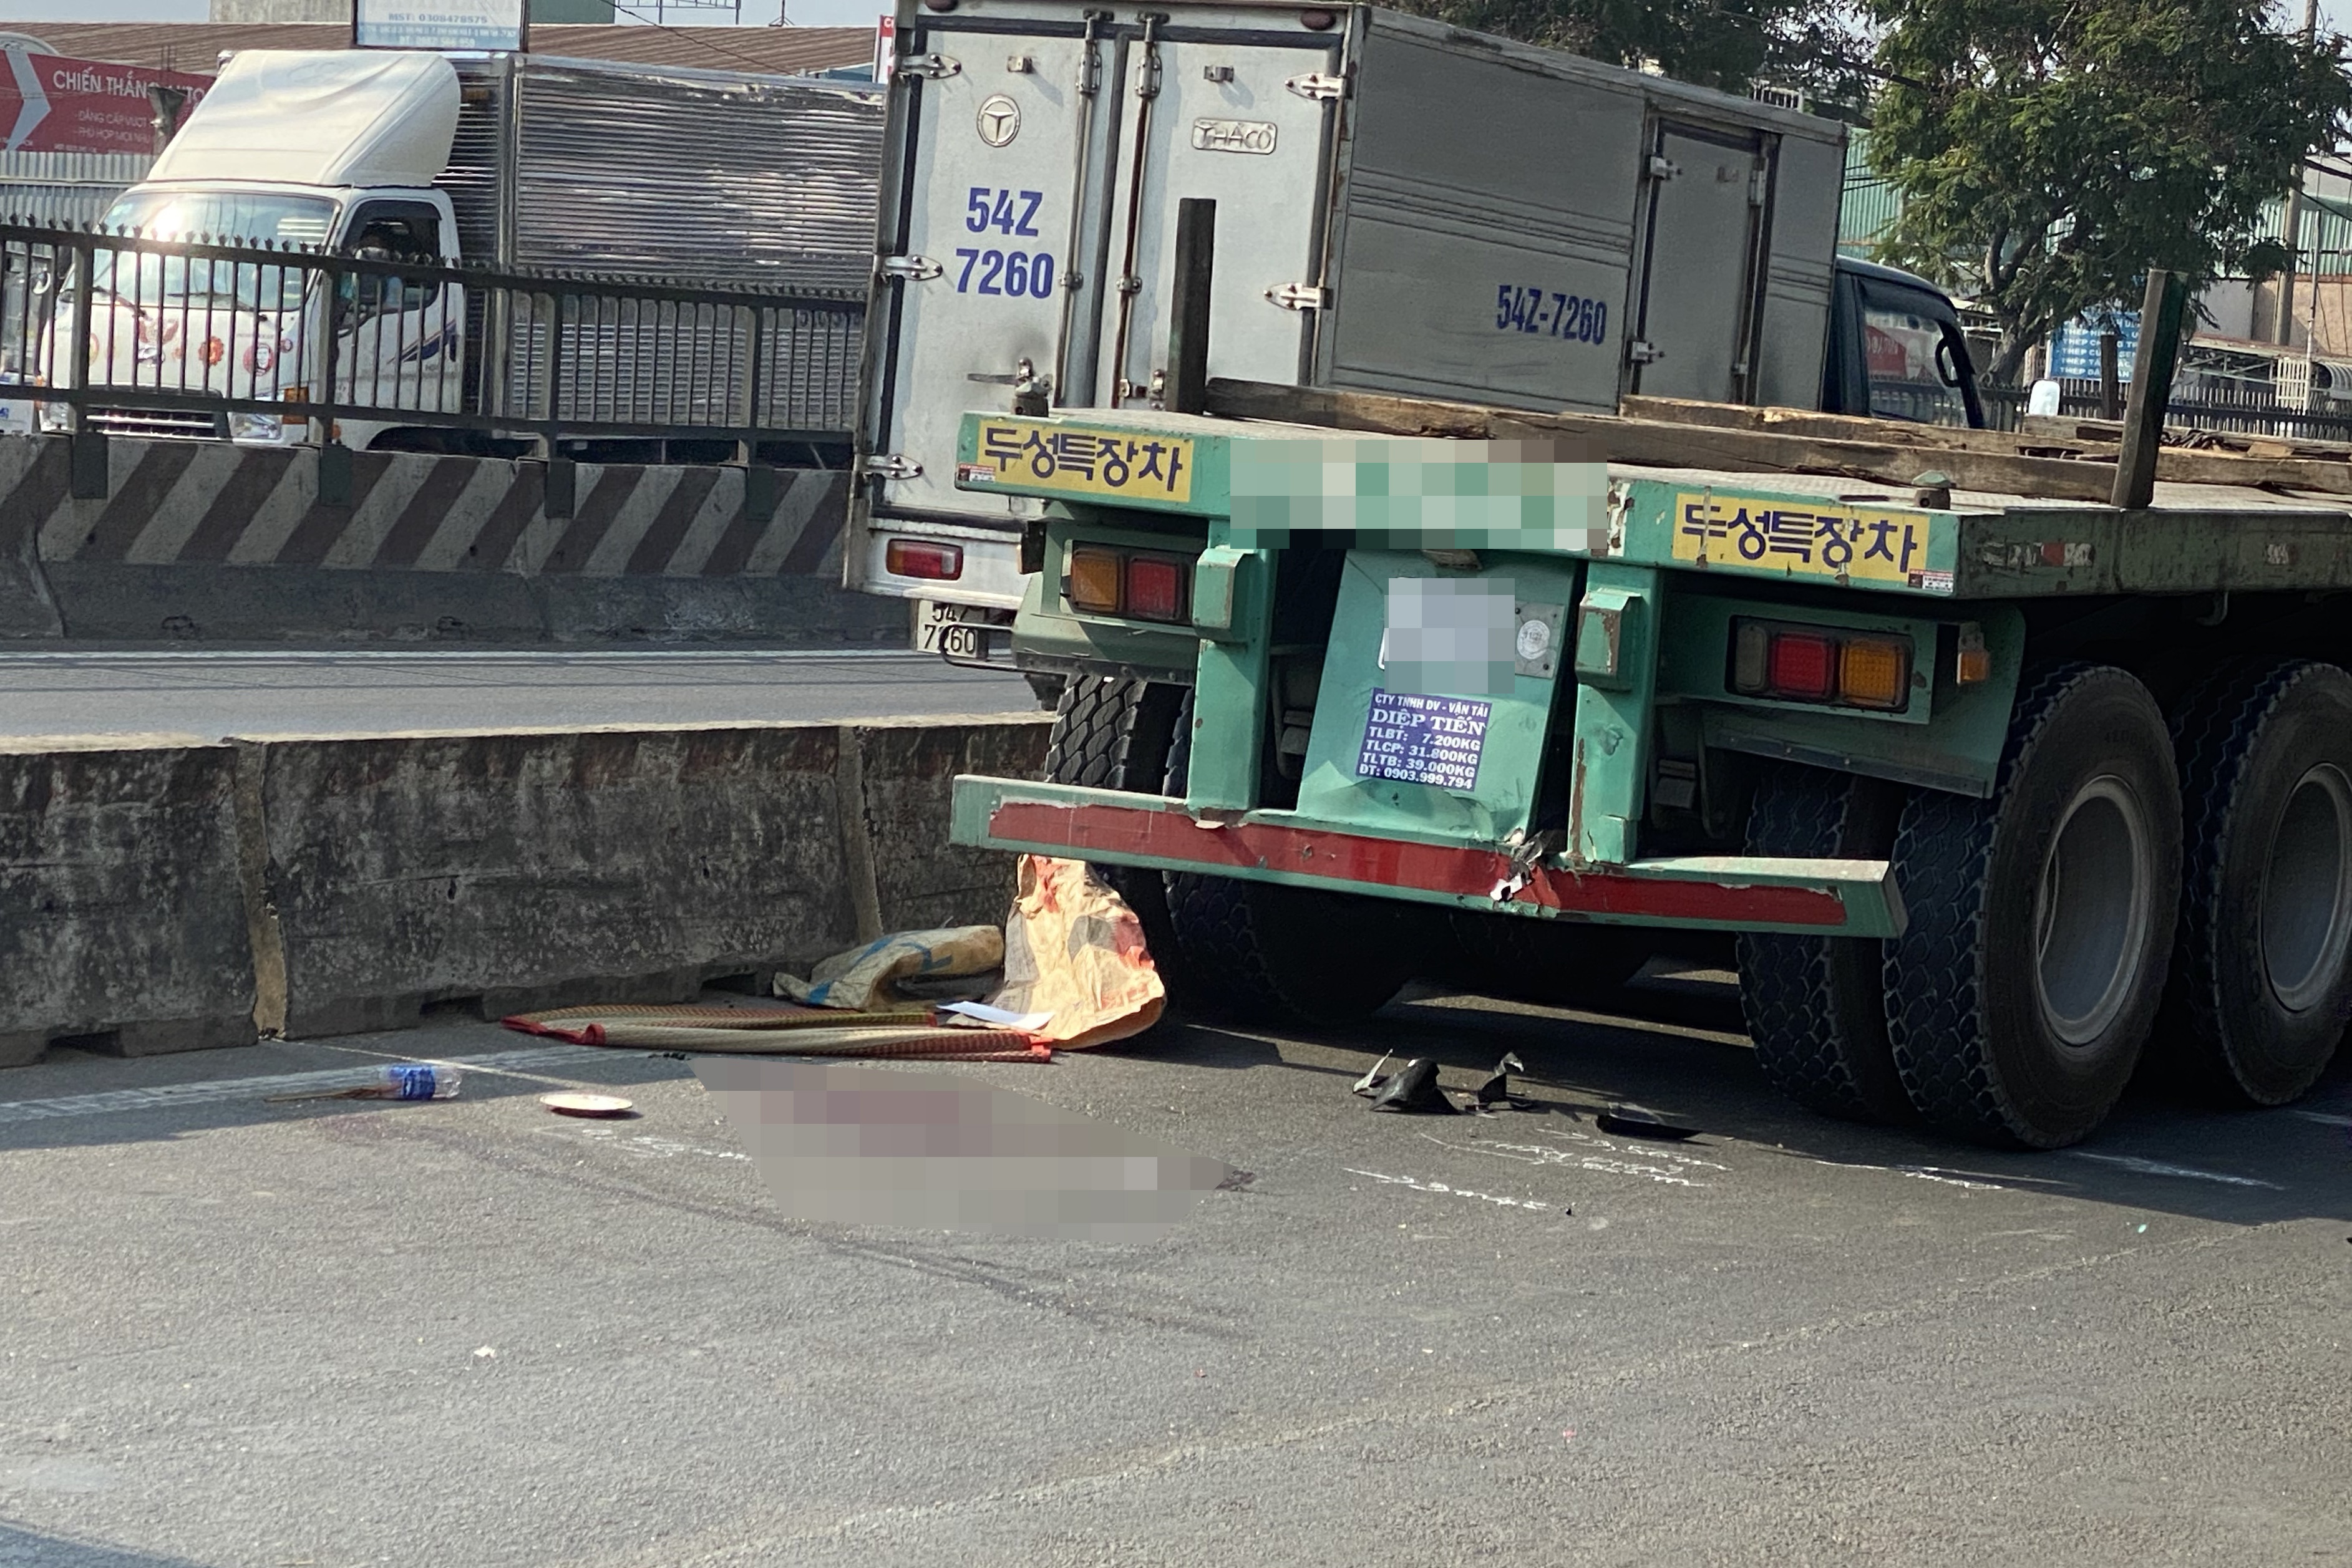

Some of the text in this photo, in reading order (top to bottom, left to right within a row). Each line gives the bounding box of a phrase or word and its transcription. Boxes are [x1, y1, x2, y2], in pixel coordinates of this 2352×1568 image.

[53, 66, 101, 92] CHIẾN
[106, 70, 158, 99] THẮN
[1194, 122, 1272, 150] THACO
[965, 187, 1043, 238] 54Z
[955, 247, 1054, 299] 7260
[1497, 284, 1608, 346] 54Z-7260
[984, 427, 1182, 493] 두성특장차
[1682, 503, 1917, 573] 두성특장차
[925, 624, 976, 653] 760
[1375, 694, 1395, 705] CTY
[1397, 696, 1424, 709] TNHH
[1426, 700, 1441, 711] DV
[1449, 702, 1470, 716] VẬN
[1472, 703, 1489, 717] TẢI
[1371, 708, 1487, 735] DIỆP TIẾN
[1366, 739, 1478, 765] TLCP: 31.800KG
[1369, 726, 1480, 752] TLBT: 7.200KG
[1363, 752, 1475, 778] TLTB: 39.000KG
[1384, 767, 1473, 790] 0903.999.794
